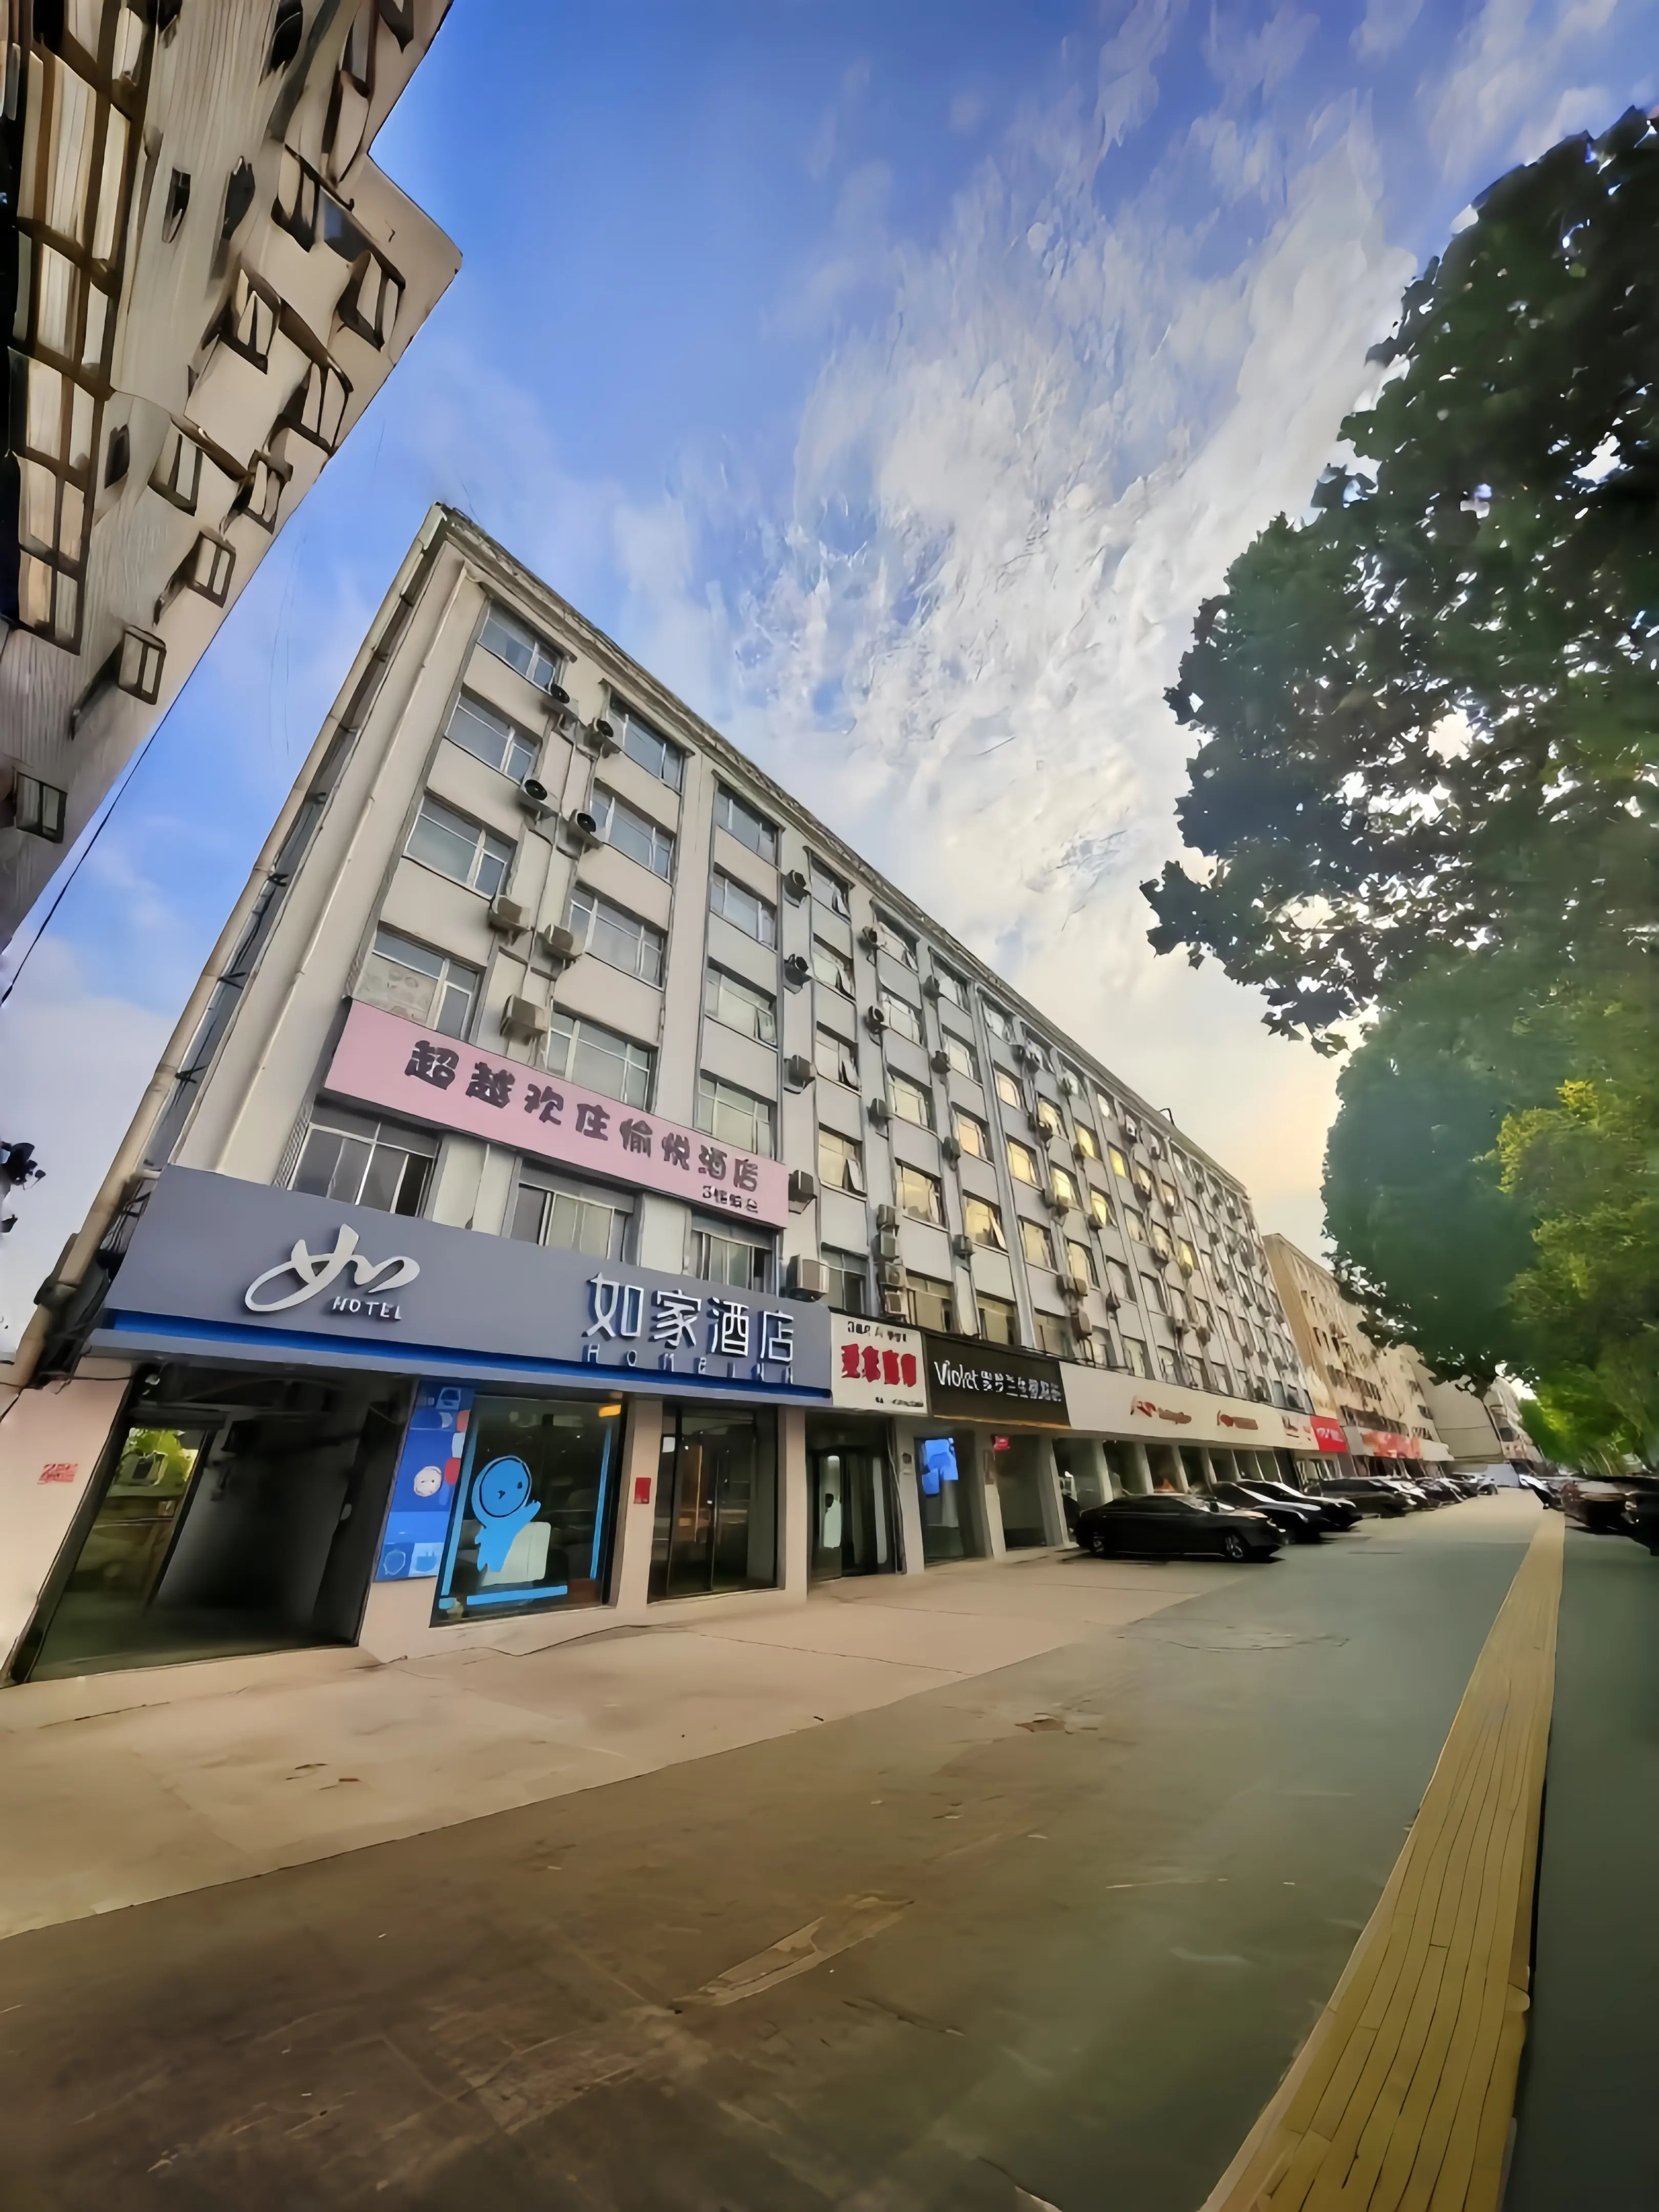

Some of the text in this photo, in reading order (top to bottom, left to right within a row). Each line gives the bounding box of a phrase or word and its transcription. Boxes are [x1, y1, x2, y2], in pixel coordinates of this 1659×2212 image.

[333, 1296, 402, 1320] HOTEL
[585, 1272, 794, 1363] 如家酒店
[933, 1359, 979, 1391] Violet
